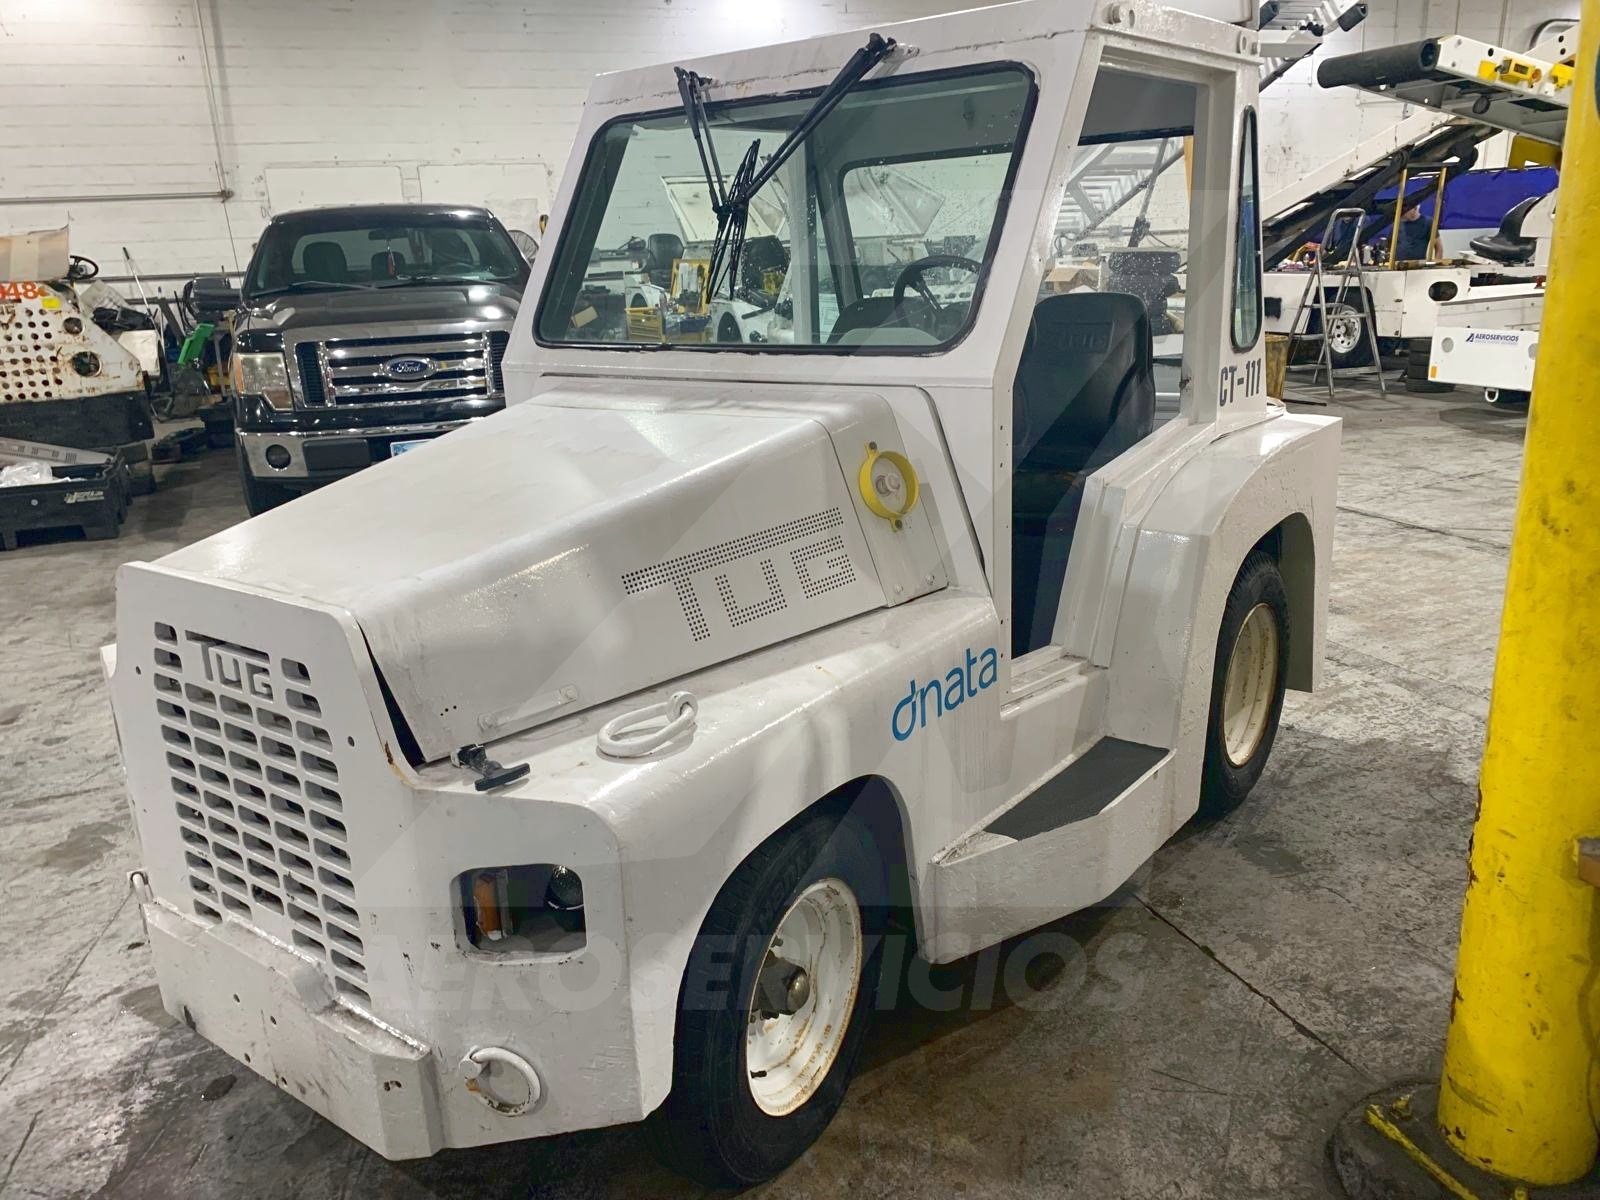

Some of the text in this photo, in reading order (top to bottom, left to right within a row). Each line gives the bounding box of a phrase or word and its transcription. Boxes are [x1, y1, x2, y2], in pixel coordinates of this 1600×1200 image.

[396, 362, 421, 373] Ford
[1475, 333, 1519, 342] AEROSERVICIOS
[1219, 358, 1262, 407] CT-111
[621, 506, 857, 642] TUG
[184, 630, 274, 701] TUG
[892, 647, 997, 741] dnata
